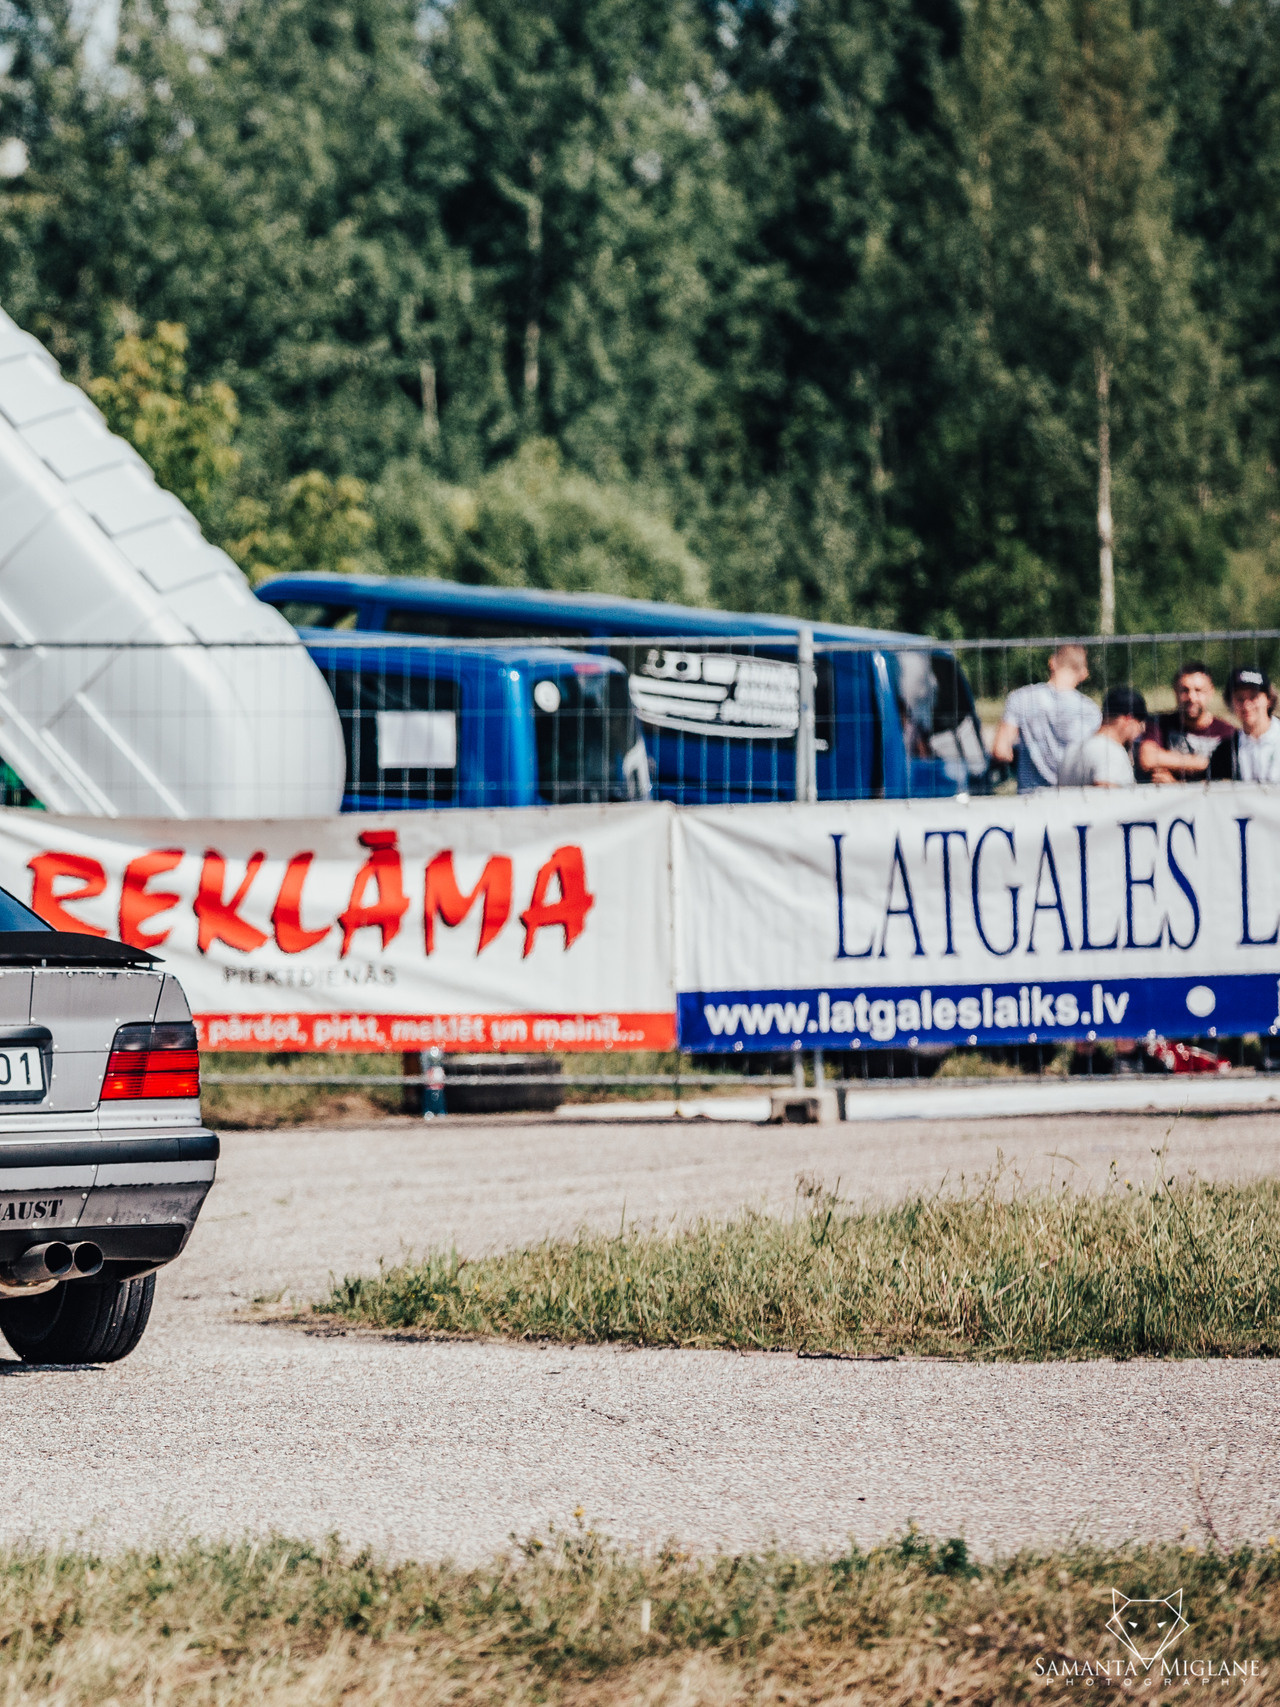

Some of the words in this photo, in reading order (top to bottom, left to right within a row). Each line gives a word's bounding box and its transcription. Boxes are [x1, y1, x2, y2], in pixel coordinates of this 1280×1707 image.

[26, 829, 595, 959] REKLĀMA
[828, 817, 1201, 960] LATGALES
[490, 1018, 528, 1042] un
[704, 984, 1130, 1041] www.latgaleslaiks.lv
